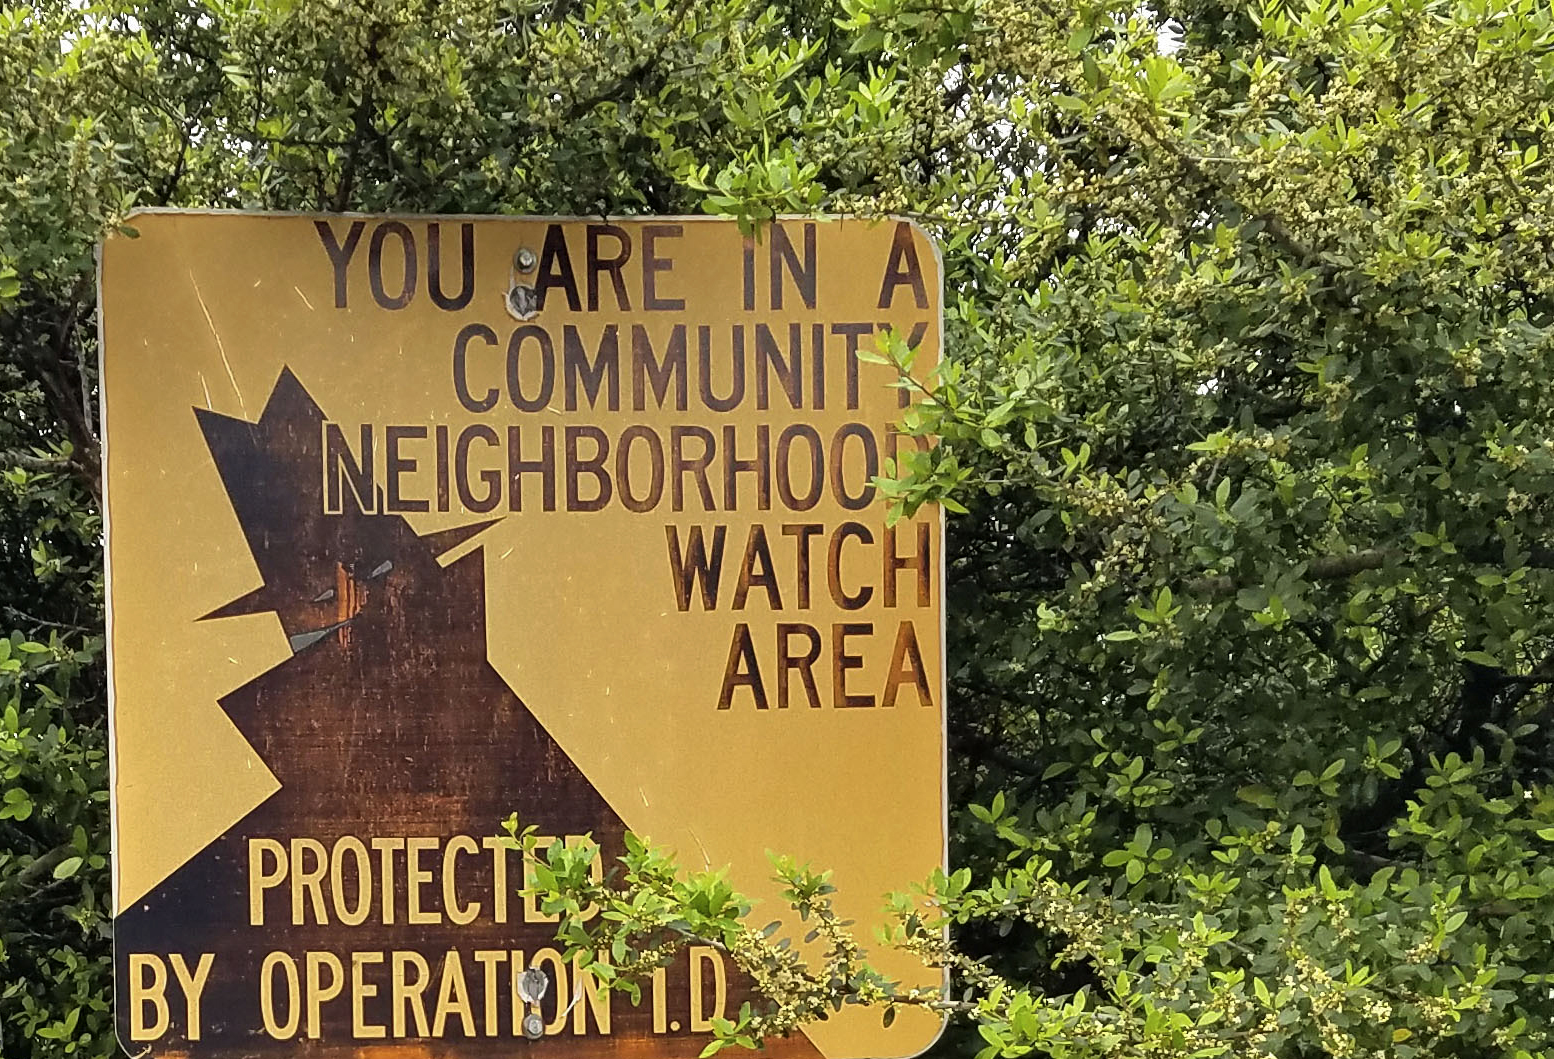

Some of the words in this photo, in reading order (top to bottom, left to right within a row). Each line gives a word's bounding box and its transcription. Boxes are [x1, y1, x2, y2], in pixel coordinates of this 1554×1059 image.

[314, 220, 475, 312] YOU
[534, 224, 686, 312] ARE
[742, 223, 818, 311] IN
[877, 221, 930, 309] A
[453, 321, 930, 413] COMMUNITY
[665, 521, 931, 612] WATCH
[716, 620, 934, 711] AREA
[129, 953, 216, 1042] BY
[260, 947, 612, 1040] OPERATION
